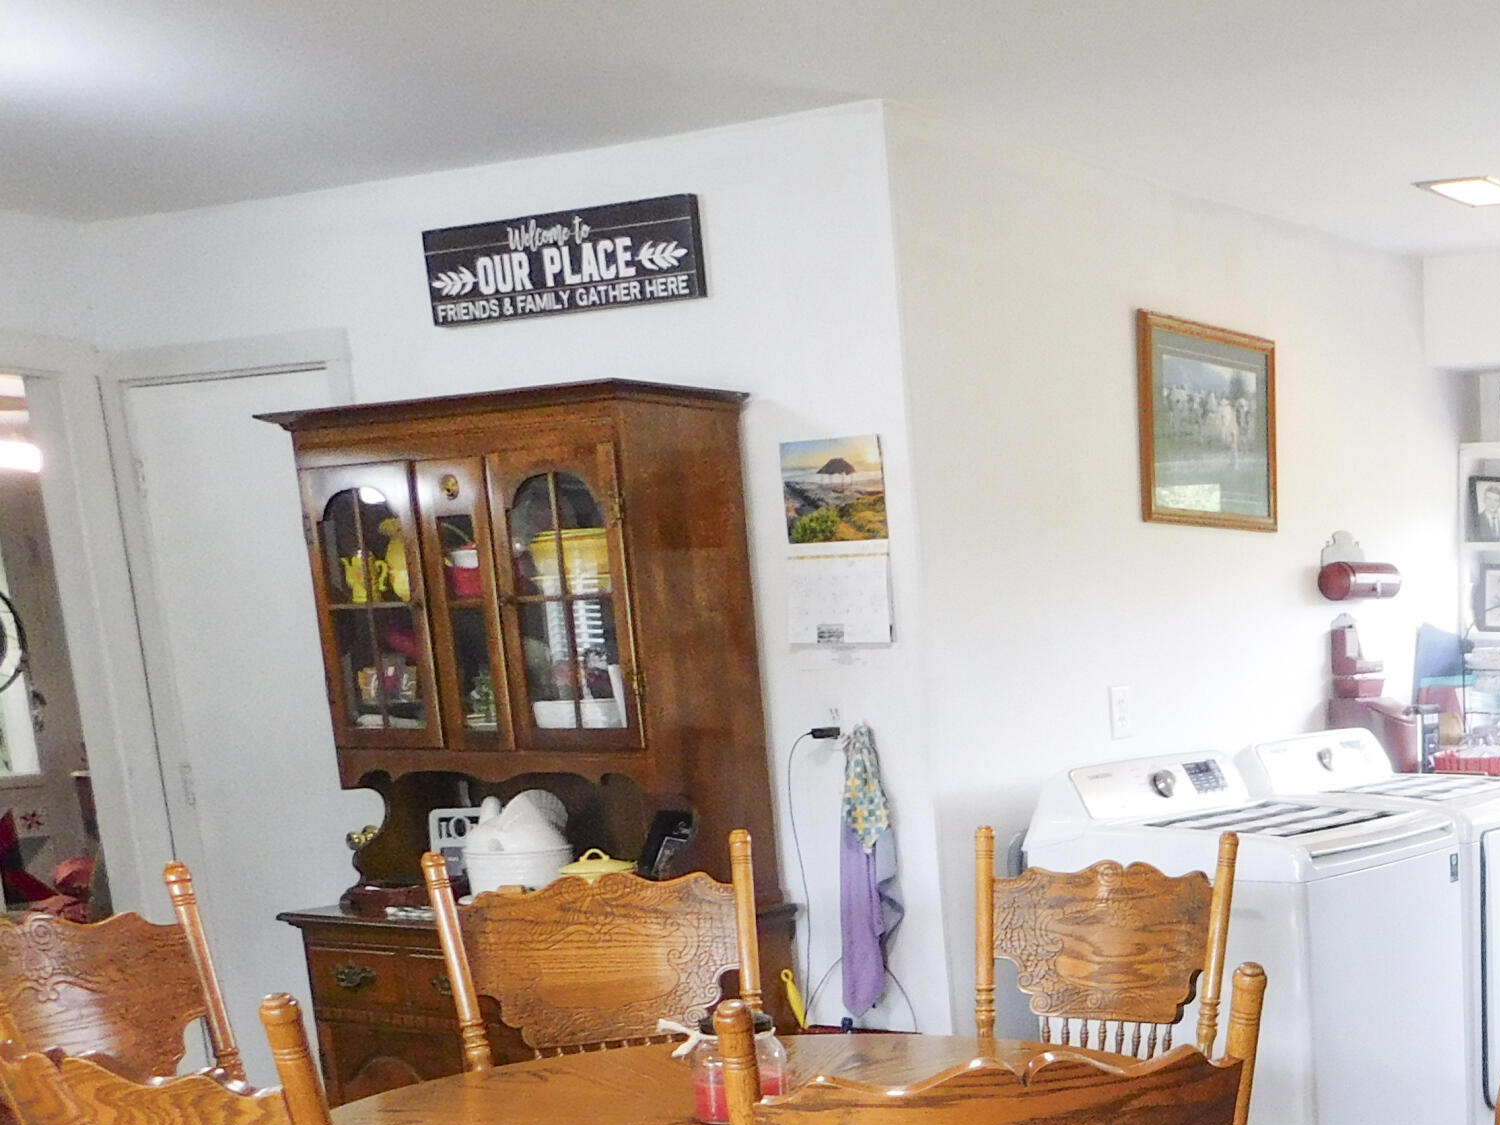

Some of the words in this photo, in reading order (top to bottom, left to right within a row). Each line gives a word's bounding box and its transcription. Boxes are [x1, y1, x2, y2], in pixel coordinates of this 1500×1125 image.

[507, 219, 570, 251] Welcome
[572, 215, 591, 245] to
[476, 251, 533, 295] OUR
[542, 236, 637, 287] PLACE
[437, 300, 500, 323] FRIENDS
[503, 297, 514, 316] &
[516, 290, 571, 314] FAMILY
[575, 280, 641, 307] GATHER
[645, 274, 690, 299] HERE
